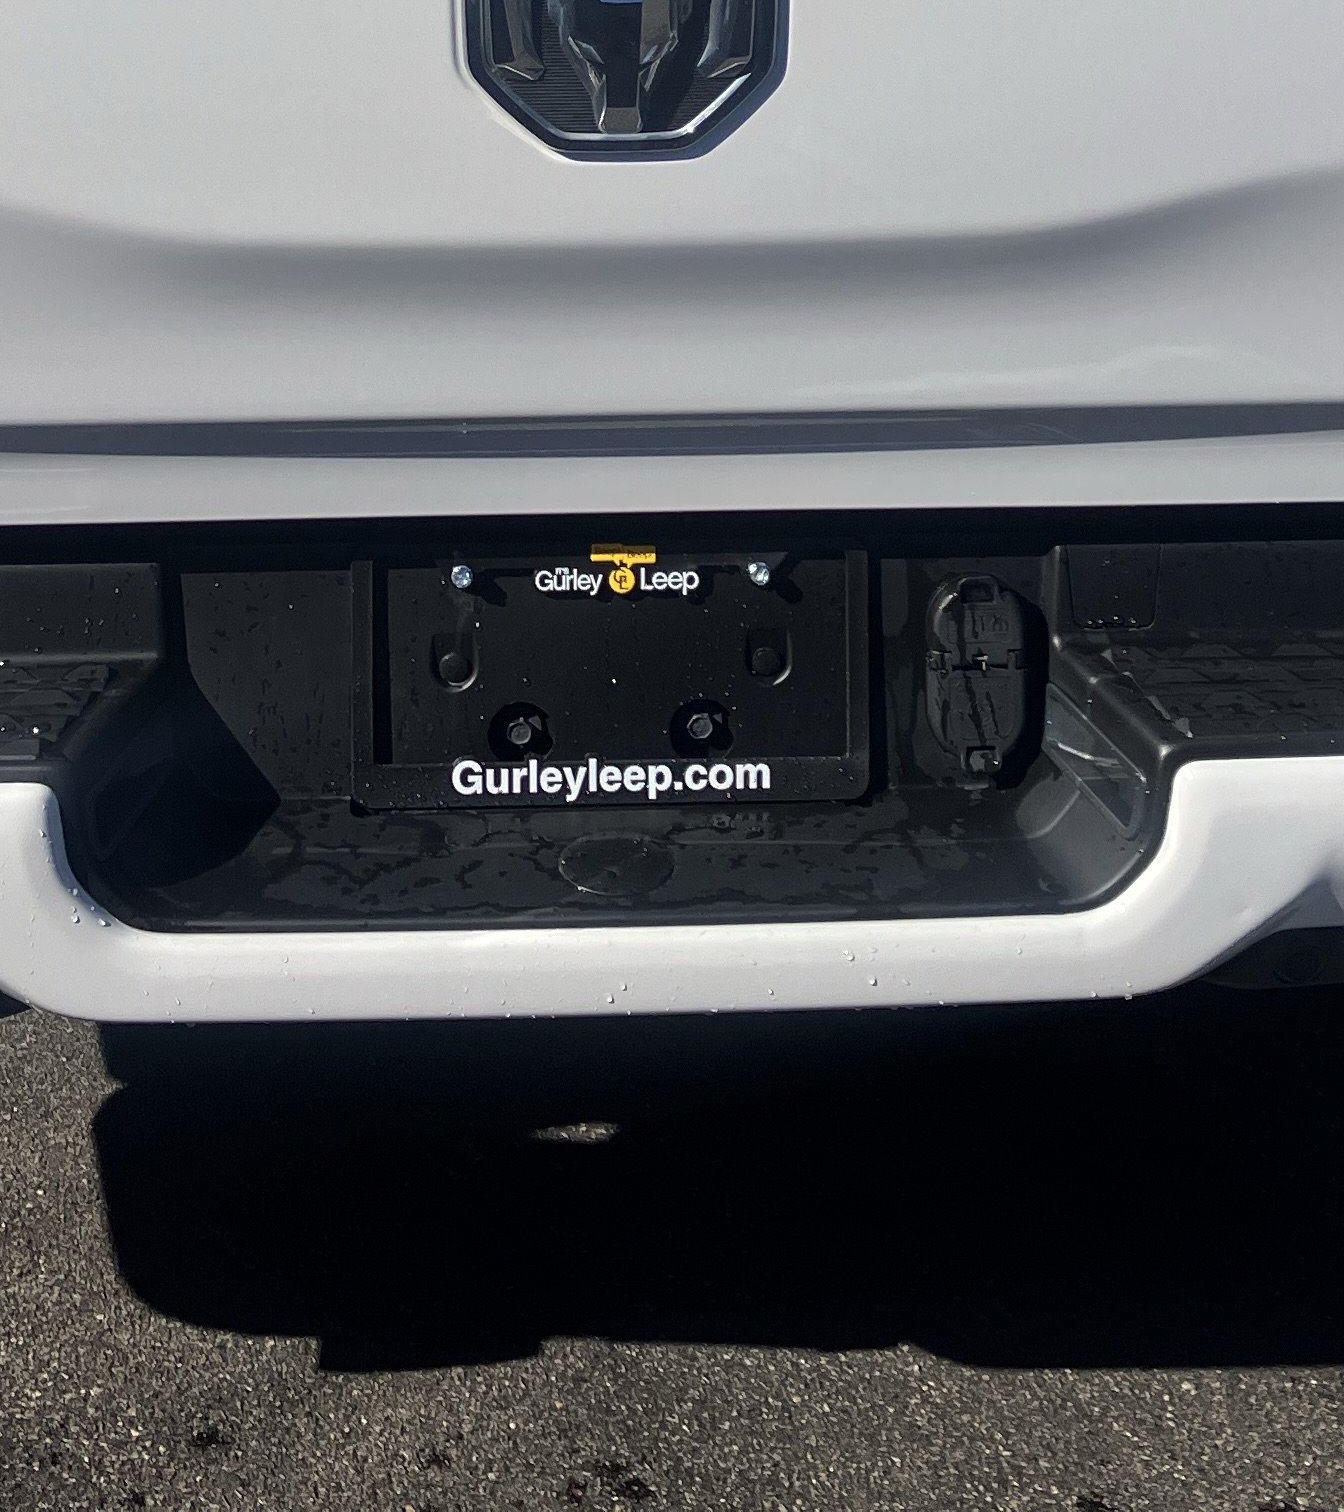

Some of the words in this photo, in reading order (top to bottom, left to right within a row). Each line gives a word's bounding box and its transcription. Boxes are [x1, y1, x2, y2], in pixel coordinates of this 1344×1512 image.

[535, 568, 604, 596] Gurley
[640, 567, 700, 596] Leep
[452, 758, 771, 802] Gurleyleep.com
